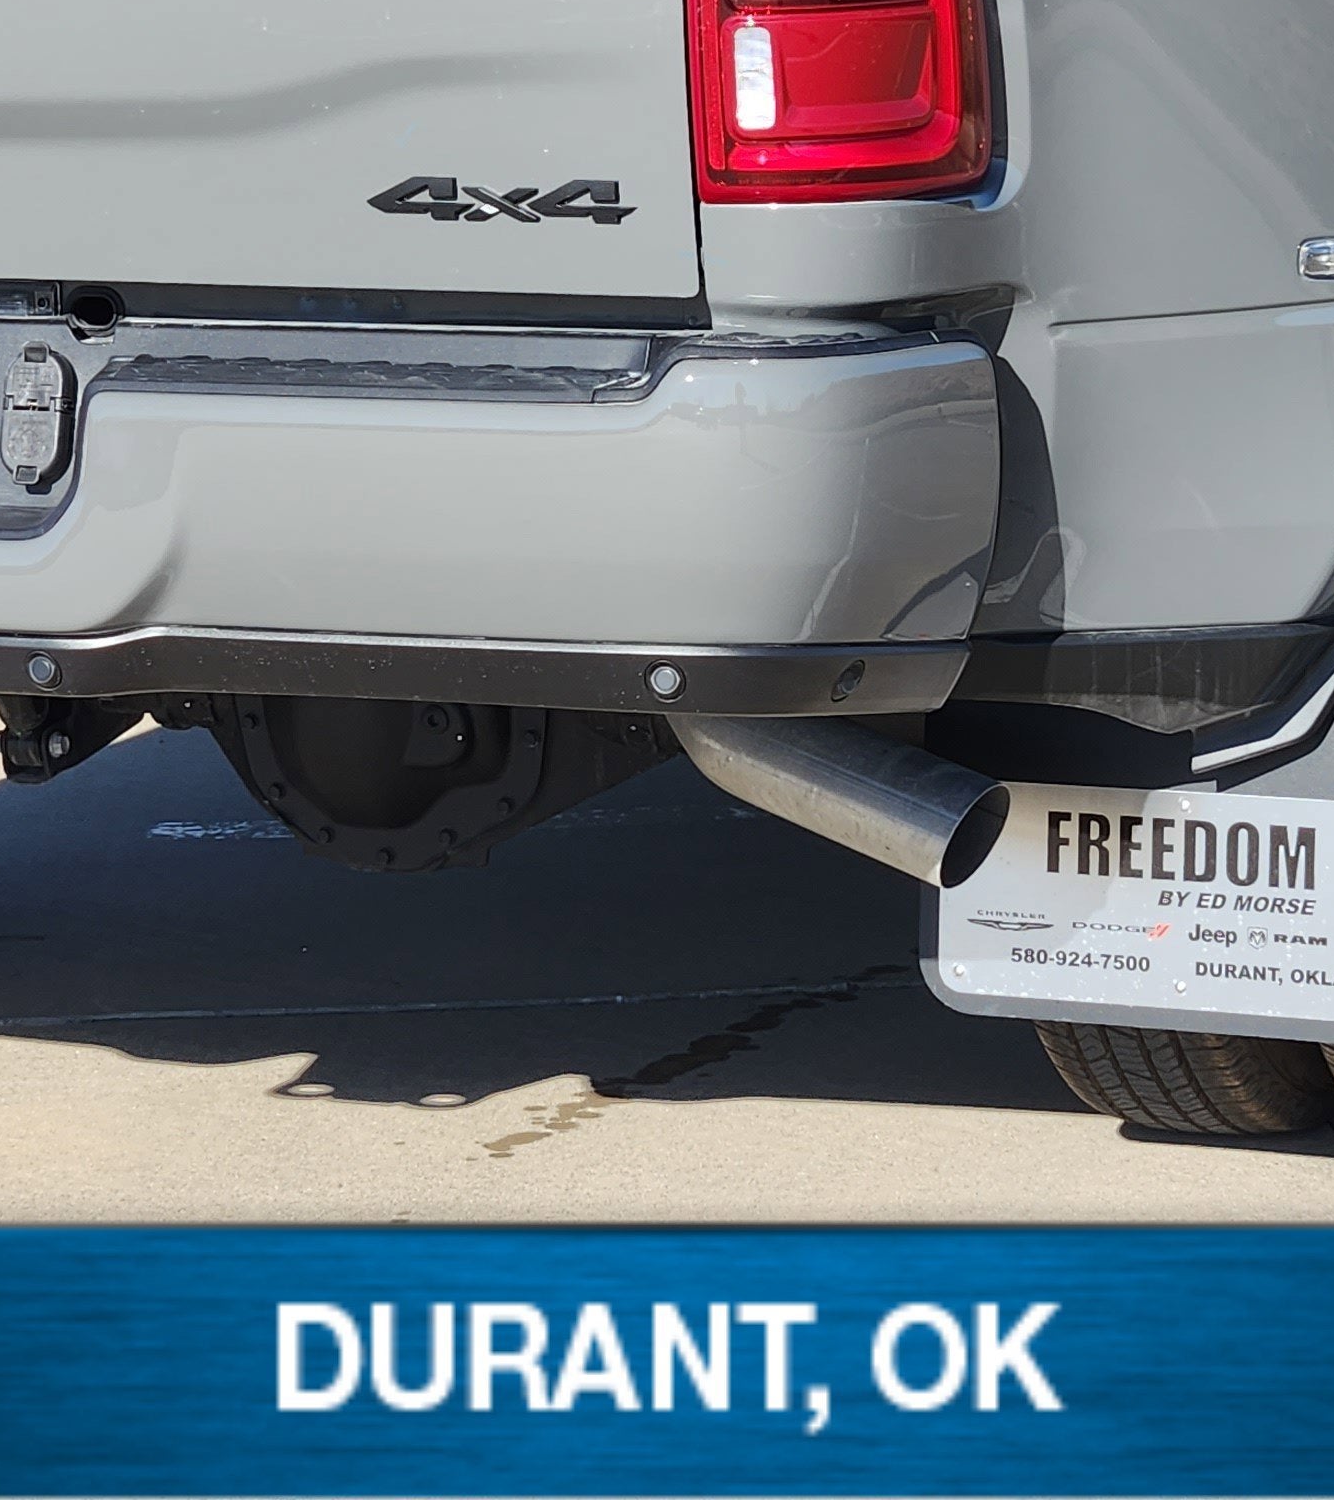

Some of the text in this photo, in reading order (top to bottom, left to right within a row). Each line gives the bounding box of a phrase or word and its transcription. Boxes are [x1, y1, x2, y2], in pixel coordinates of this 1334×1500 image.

[366, 176, 638, 225] 4x4
[1046, 810, 1317, 891] FREEDOM
[1157, 890, 1317, 916] BY ED MORSE
[976, 909, 1046, 920] CHRYSLER
[1071, 921, 1154, 934] DODGE
[1187, 924, 1238, 948] Jeep
[1273, 933, 1329, 947] RAM
[1010, 947, 1151, 973] 580-924-7500
[1195, 961, 1283, 987] DURANT,
